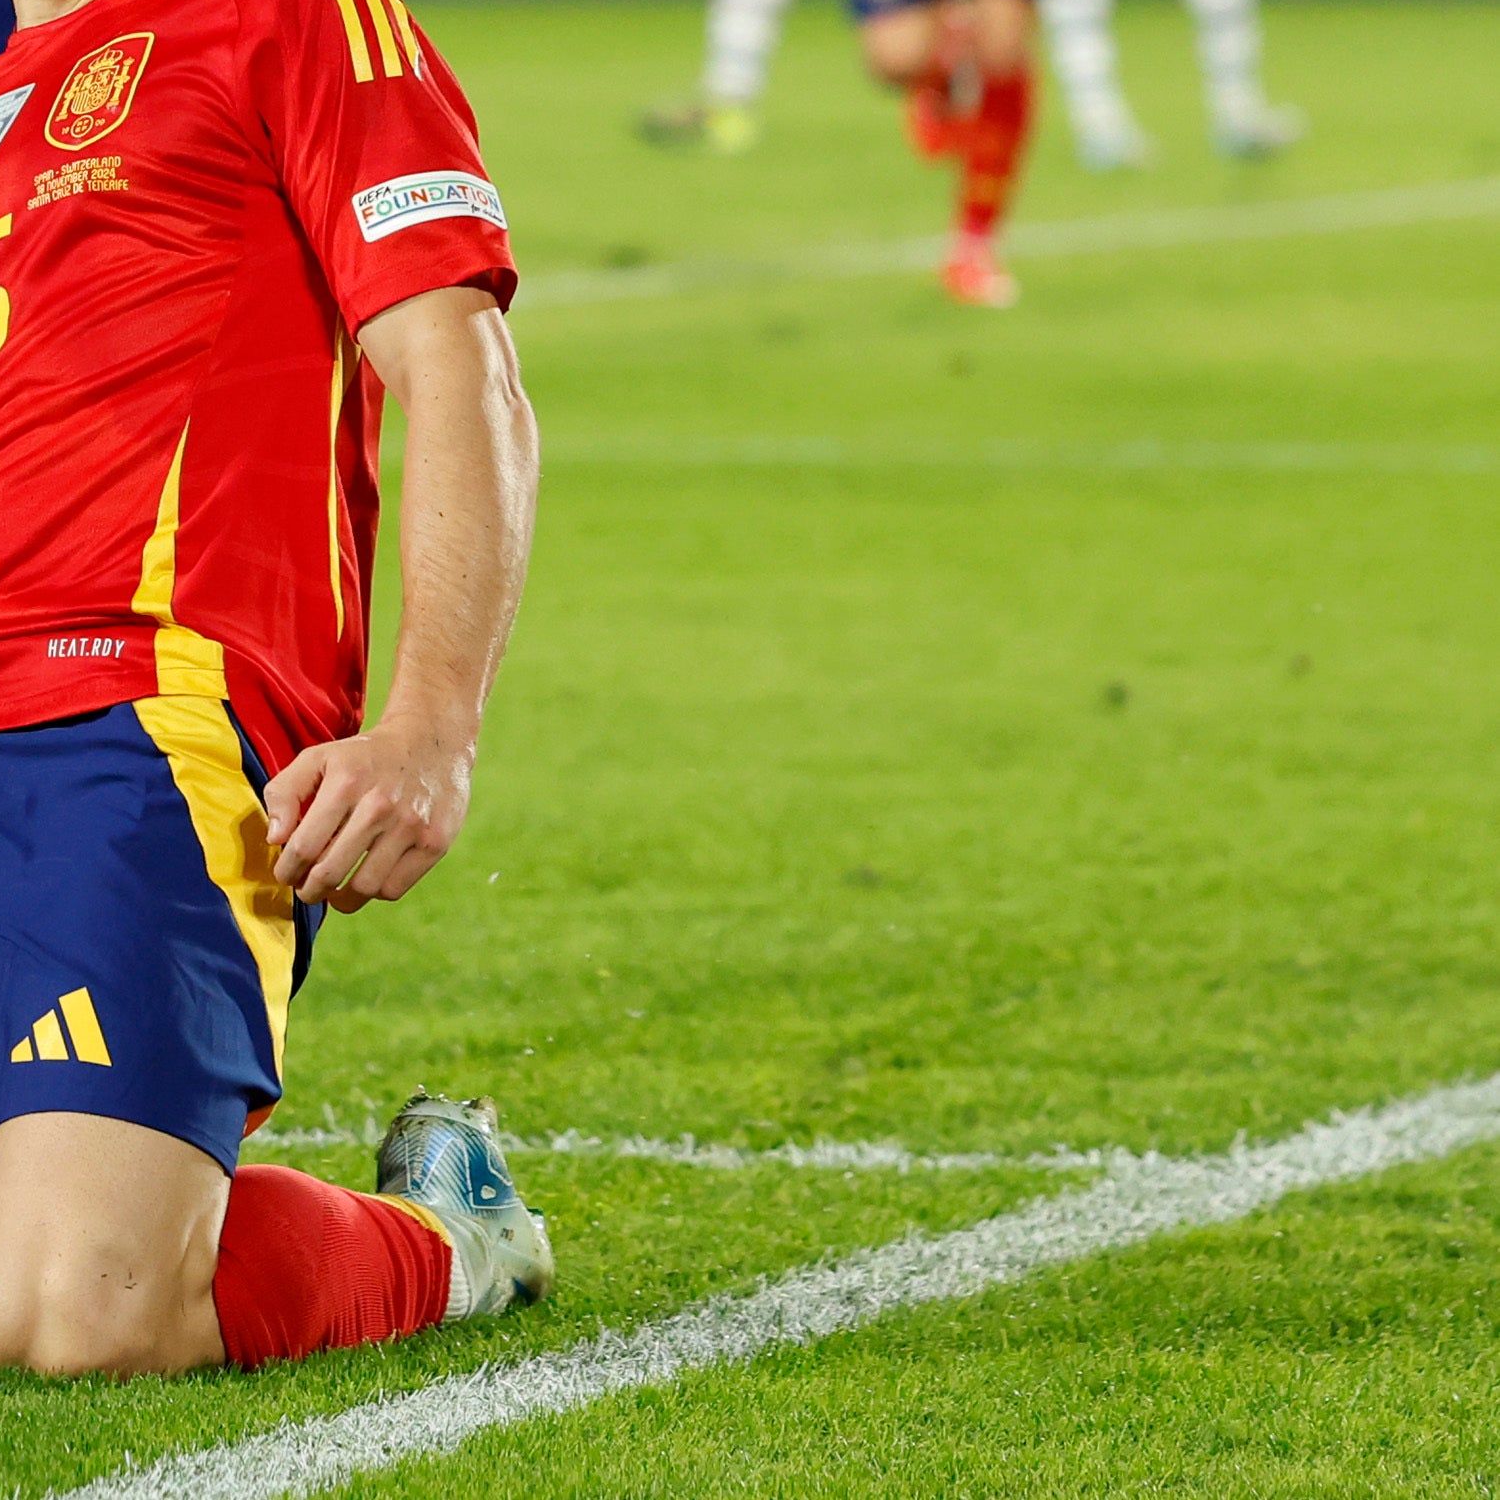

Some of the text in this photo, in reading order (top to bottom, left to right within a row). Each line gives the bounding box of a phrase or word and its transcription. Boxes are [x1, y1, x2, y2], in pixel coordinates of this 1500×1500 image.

[34, 169, 54, 186] SPAIN
[61, 156, 122, 175] SWITZERLAND
[46, 170, 88, 192] NOVEMBER
[91, 168, 116, 180] 2024
[27, 179, 129, 211] SANTA CRUZ DE TENERIFE
[358, 186, 391, 207] UEFA
[361, 184, 500, 224] FOUNDATION
[47, 637, 126, 659] HEAT.RDY
